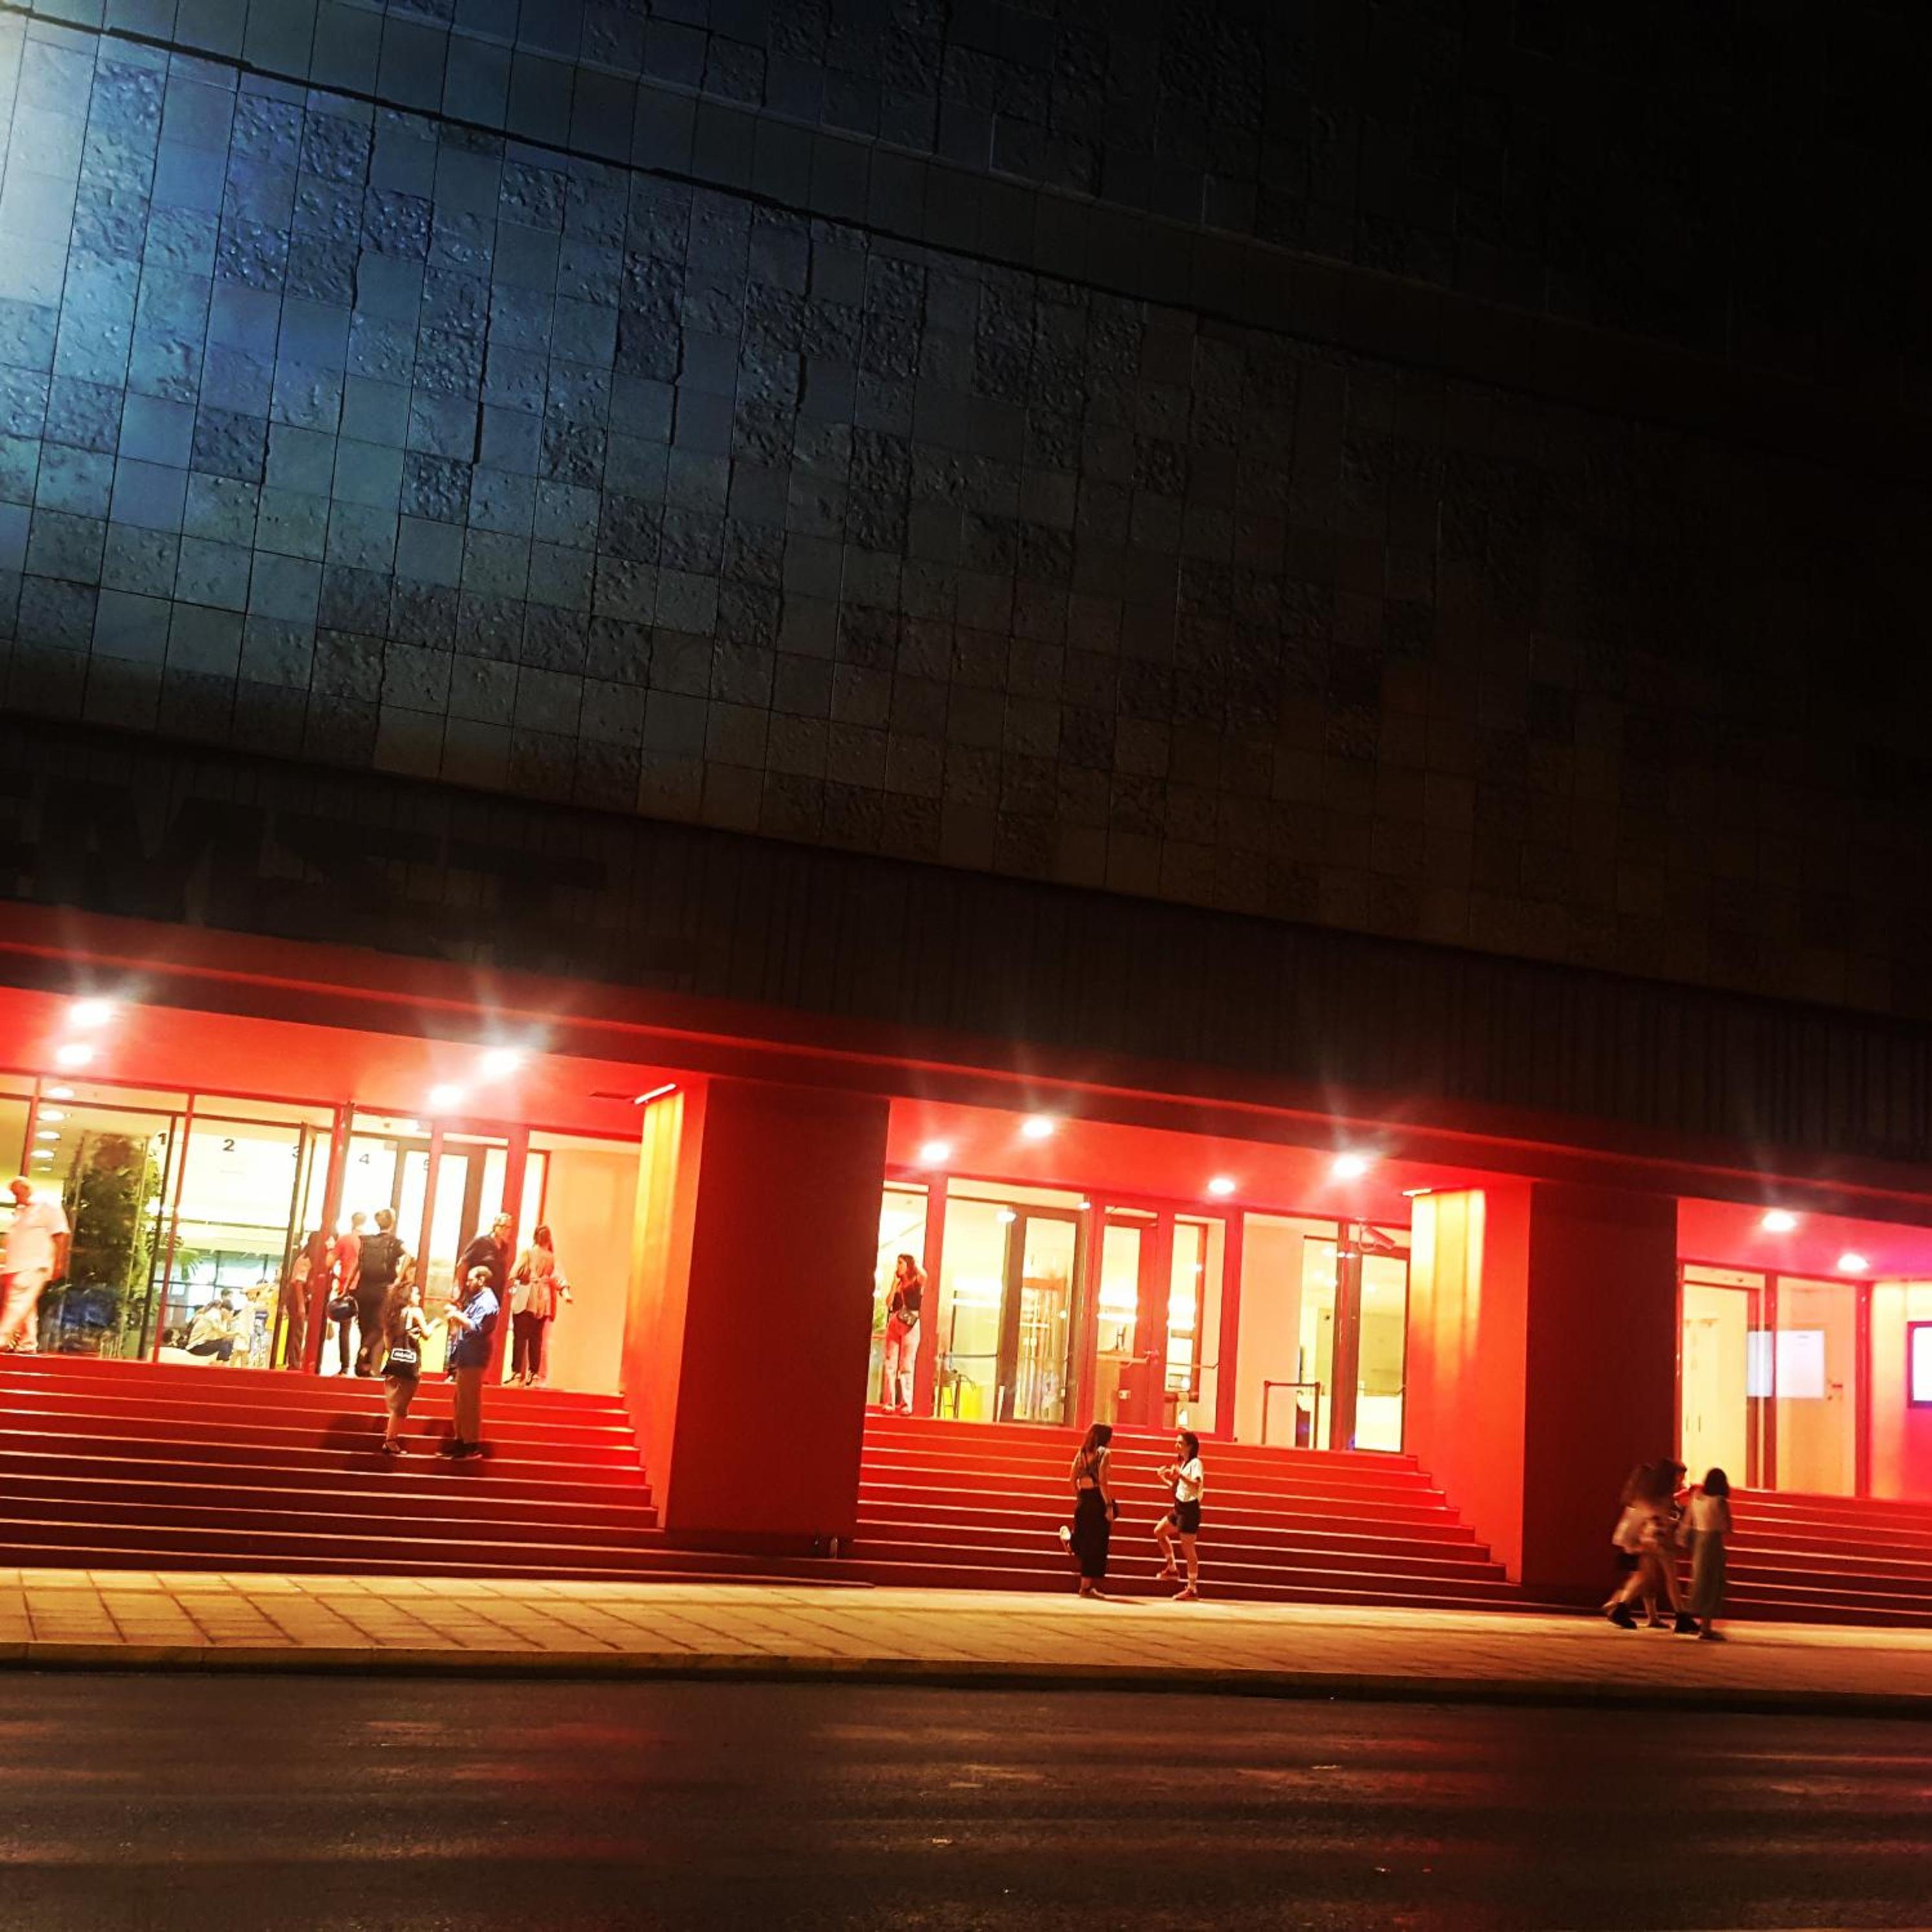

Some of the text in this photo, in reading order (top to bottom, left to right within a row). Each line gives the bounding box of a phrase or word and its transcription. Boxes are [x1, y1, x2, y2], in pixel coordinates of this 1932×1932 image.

[158, 1133, 167, 1145] 1
[222, 1138, 235, 1152] 2
[359, 1154, 370, 1165] 4
